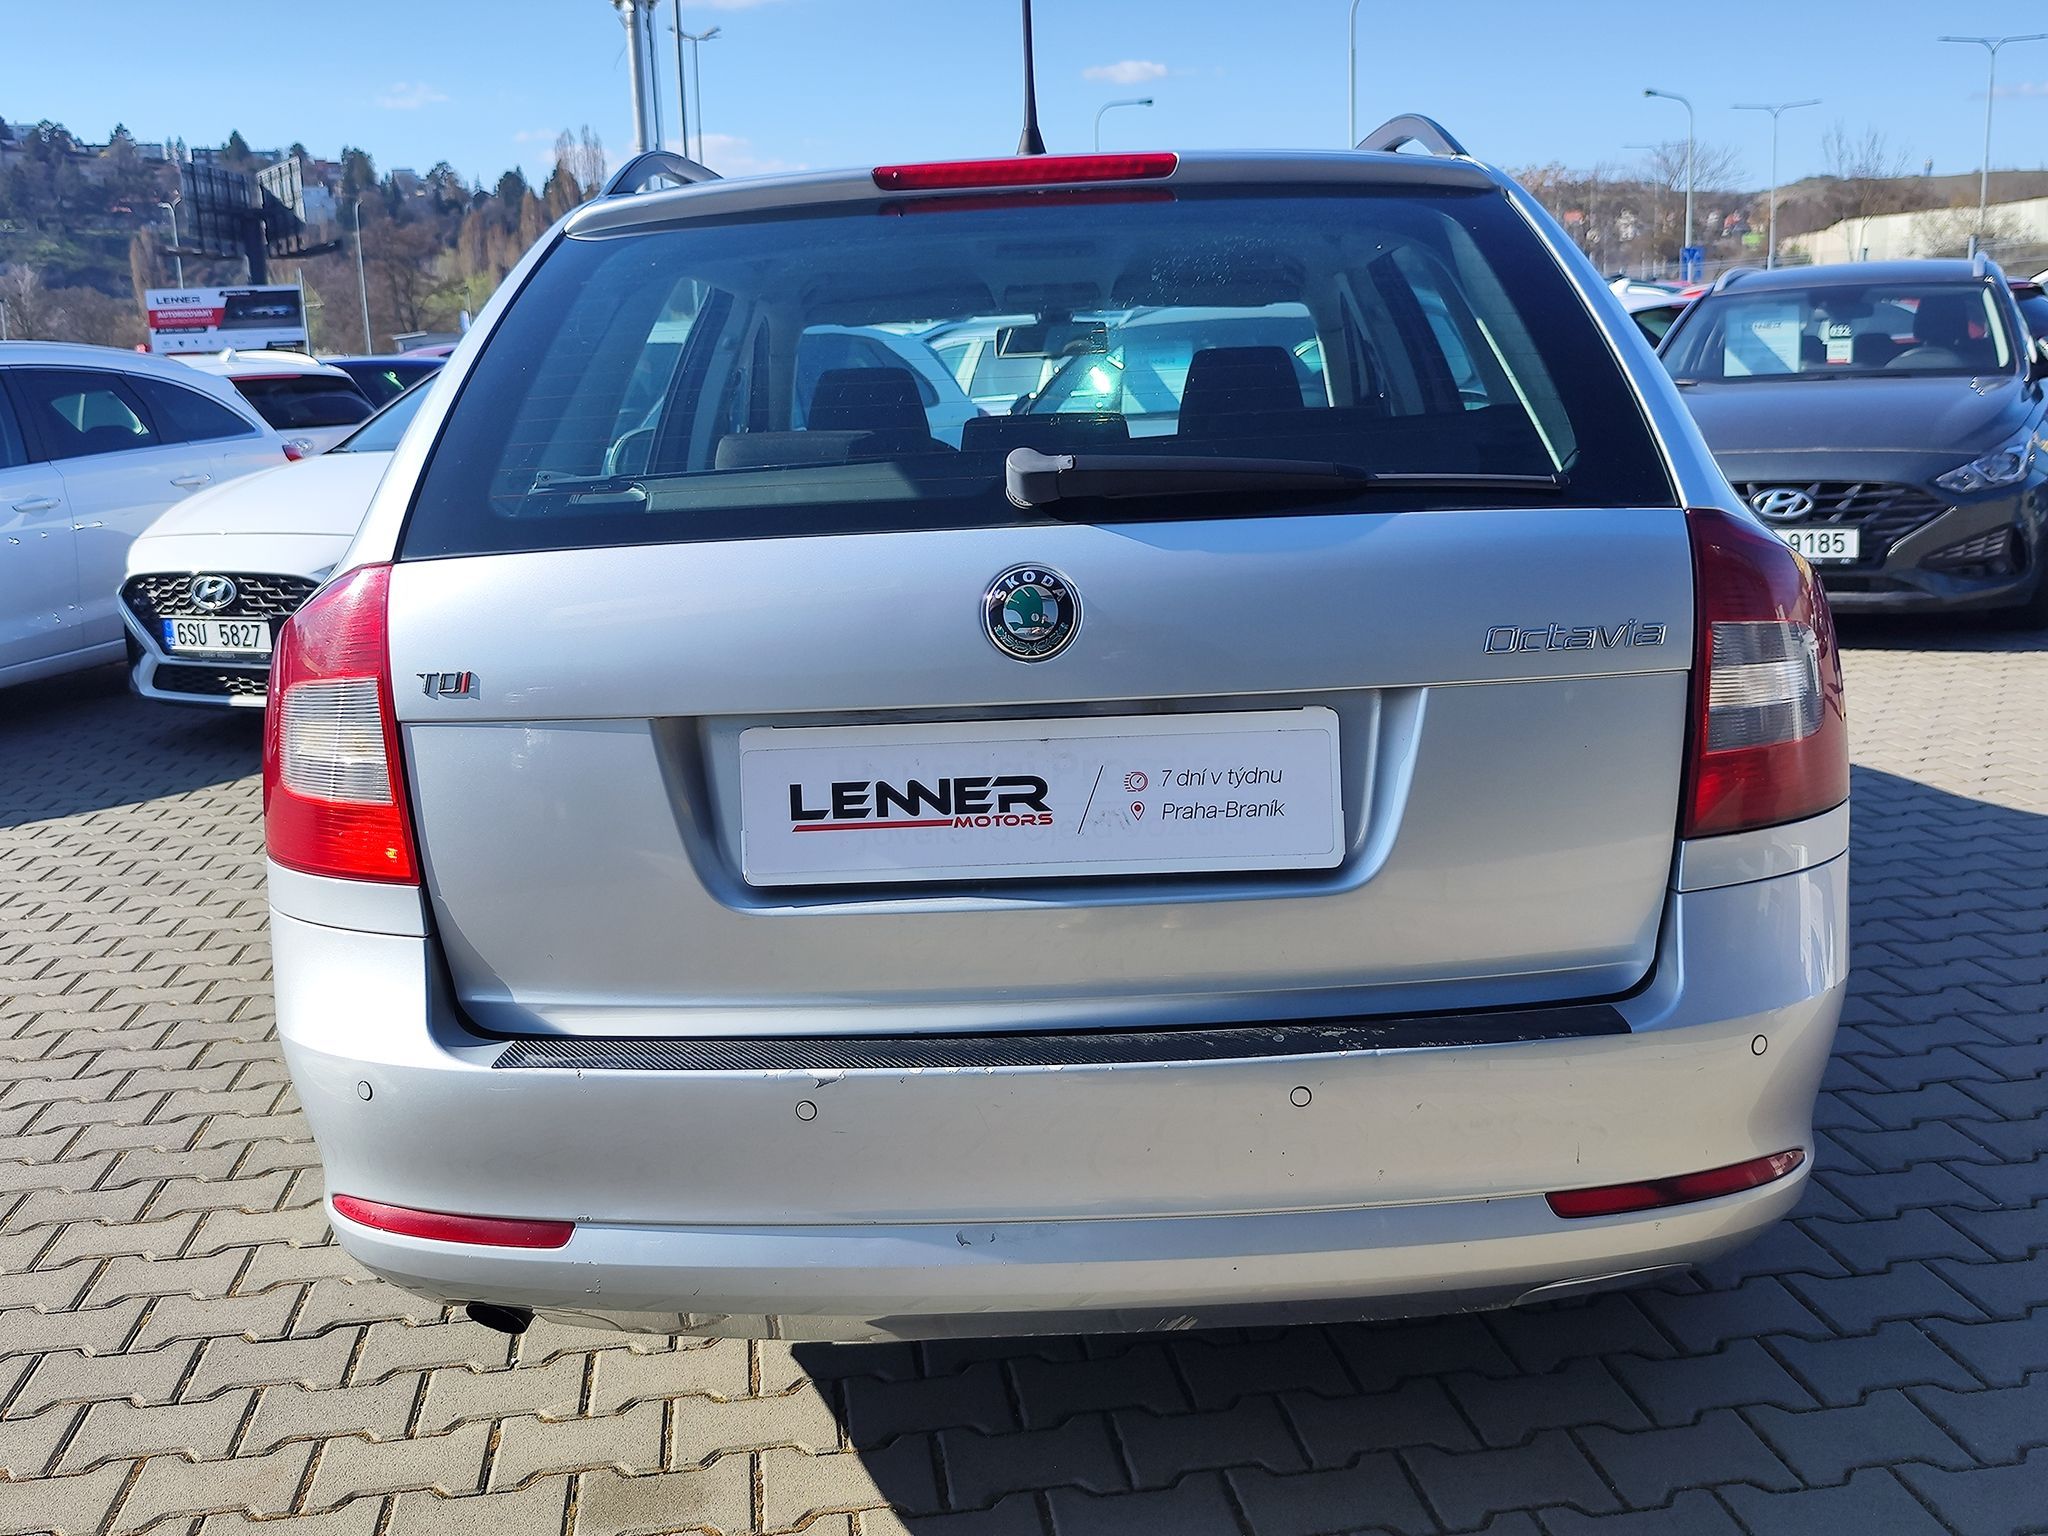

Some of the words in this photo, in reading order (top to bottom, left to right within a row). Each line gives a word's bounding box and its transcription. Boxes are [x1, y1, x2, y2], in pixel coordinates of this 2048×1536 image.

[156, 296, 201, 305] LENNER
[1789, 533, 1845, 553] 9185
[177, 622, 207, 645] 6SU
[219, 624, 260, 647] 5827
[1483, 618, 1667, 655] Octavia
[416, 671, 472, 695] TDI
[1161, 769, 1173, 787] 7
[1176, 768, 1208, 787] dní
[1210, 771, 1223, 785] v
[1228, 766, 1283, 789] týdnu
[789, 775, 1053, 821] LENNER
[953, 814, 1053, 829] MOTORS
[1161, 799, 1286, 821] Praha-Braník
